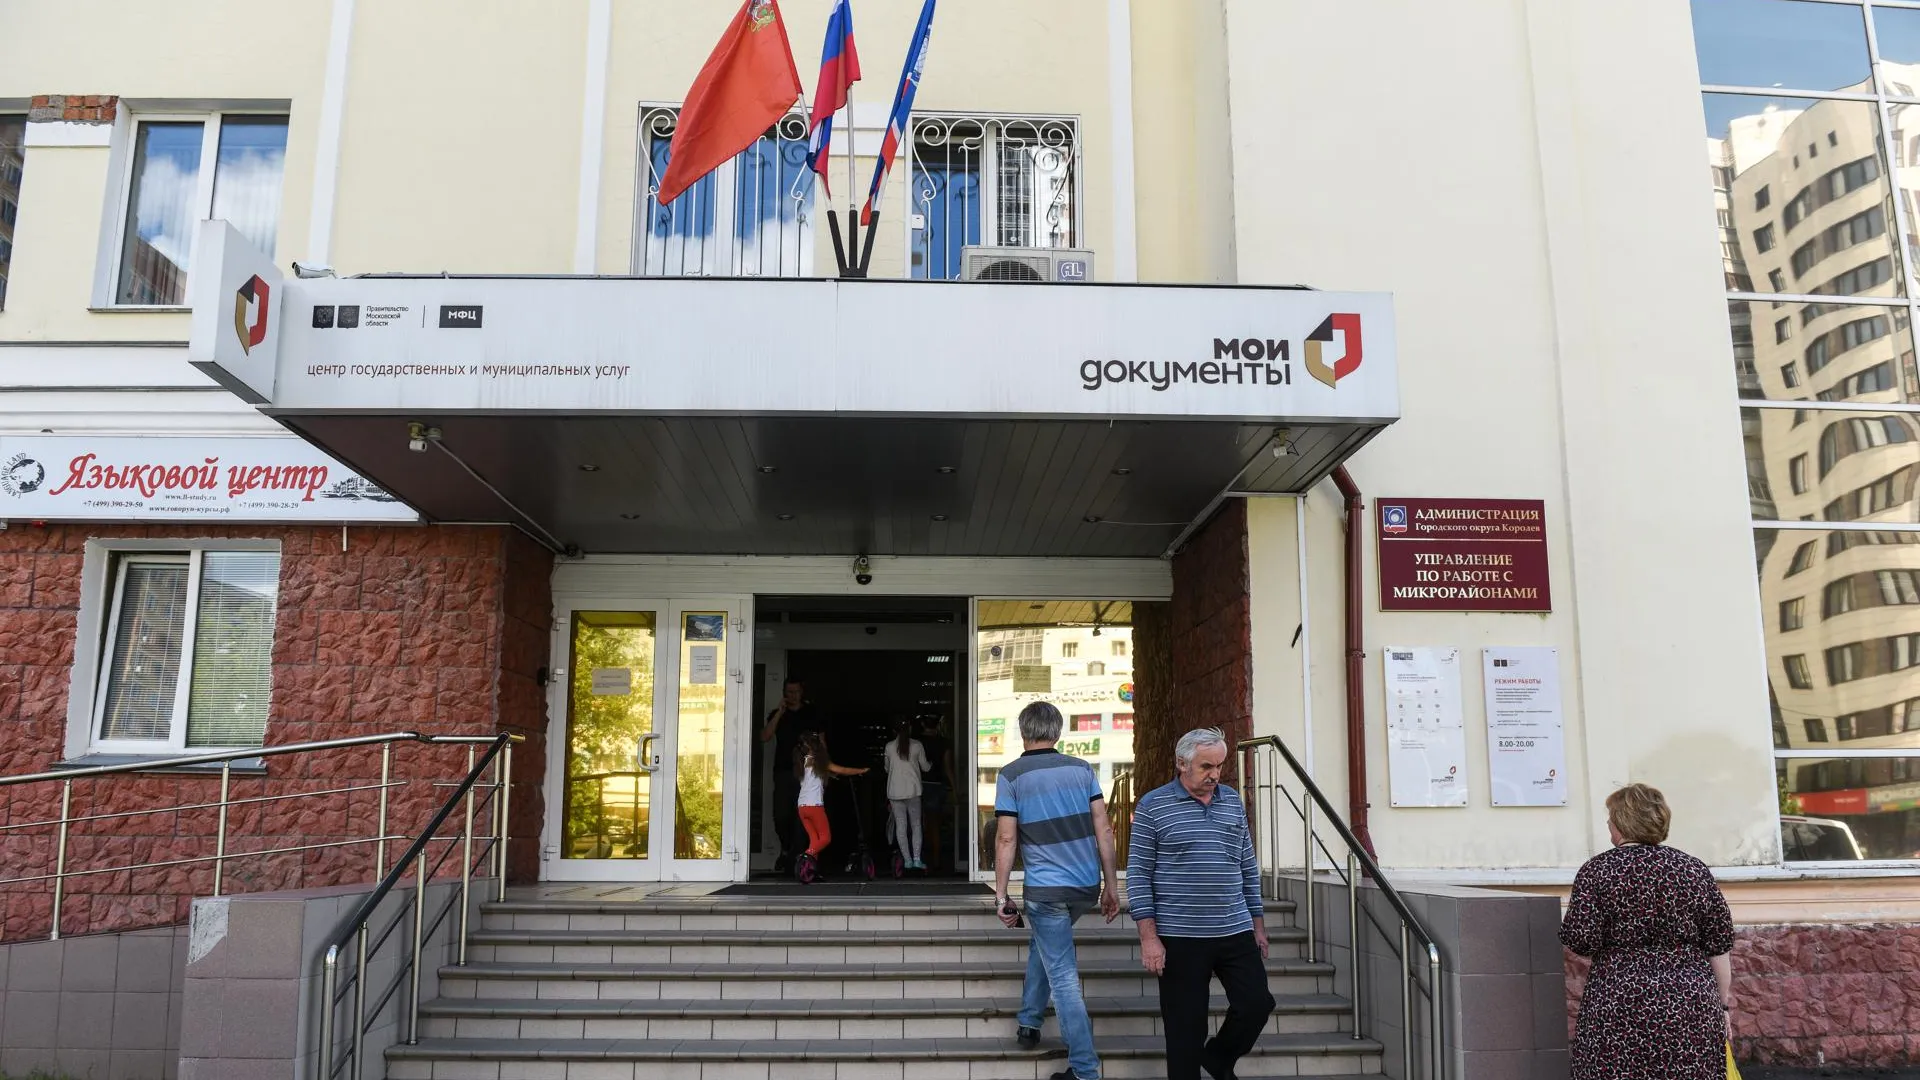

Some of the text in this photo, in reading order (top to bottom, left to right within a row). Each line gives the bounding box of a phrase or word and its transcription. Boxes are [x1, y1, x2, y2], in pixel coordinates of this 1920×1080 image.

[366, 305, 410, 313] Правительство
[448, 310, 477, 321] МФЦ
[307, 364, 632, 379] центр государственных и муниципальных услуг
[1080, 358, 1291, 391] документы
[49, 453, 328, 502] Языковой центр
[1415, 509, 1540, 521] АДМИНИСТРАЦИЯ
[1415, 523, 1468, 533] Городского
[1469, 524, 1500, 533] округа
[1414, 553, 1513, 566] УПРАВЛЕНИЕ
[1416, 570, 1513, 582] ПО РАБОТЕ С
[1393, 585, 1538, 599] МИКРОРАЙОНАМИ
[1498, 740, 1535, 748] 8.00-20.00
